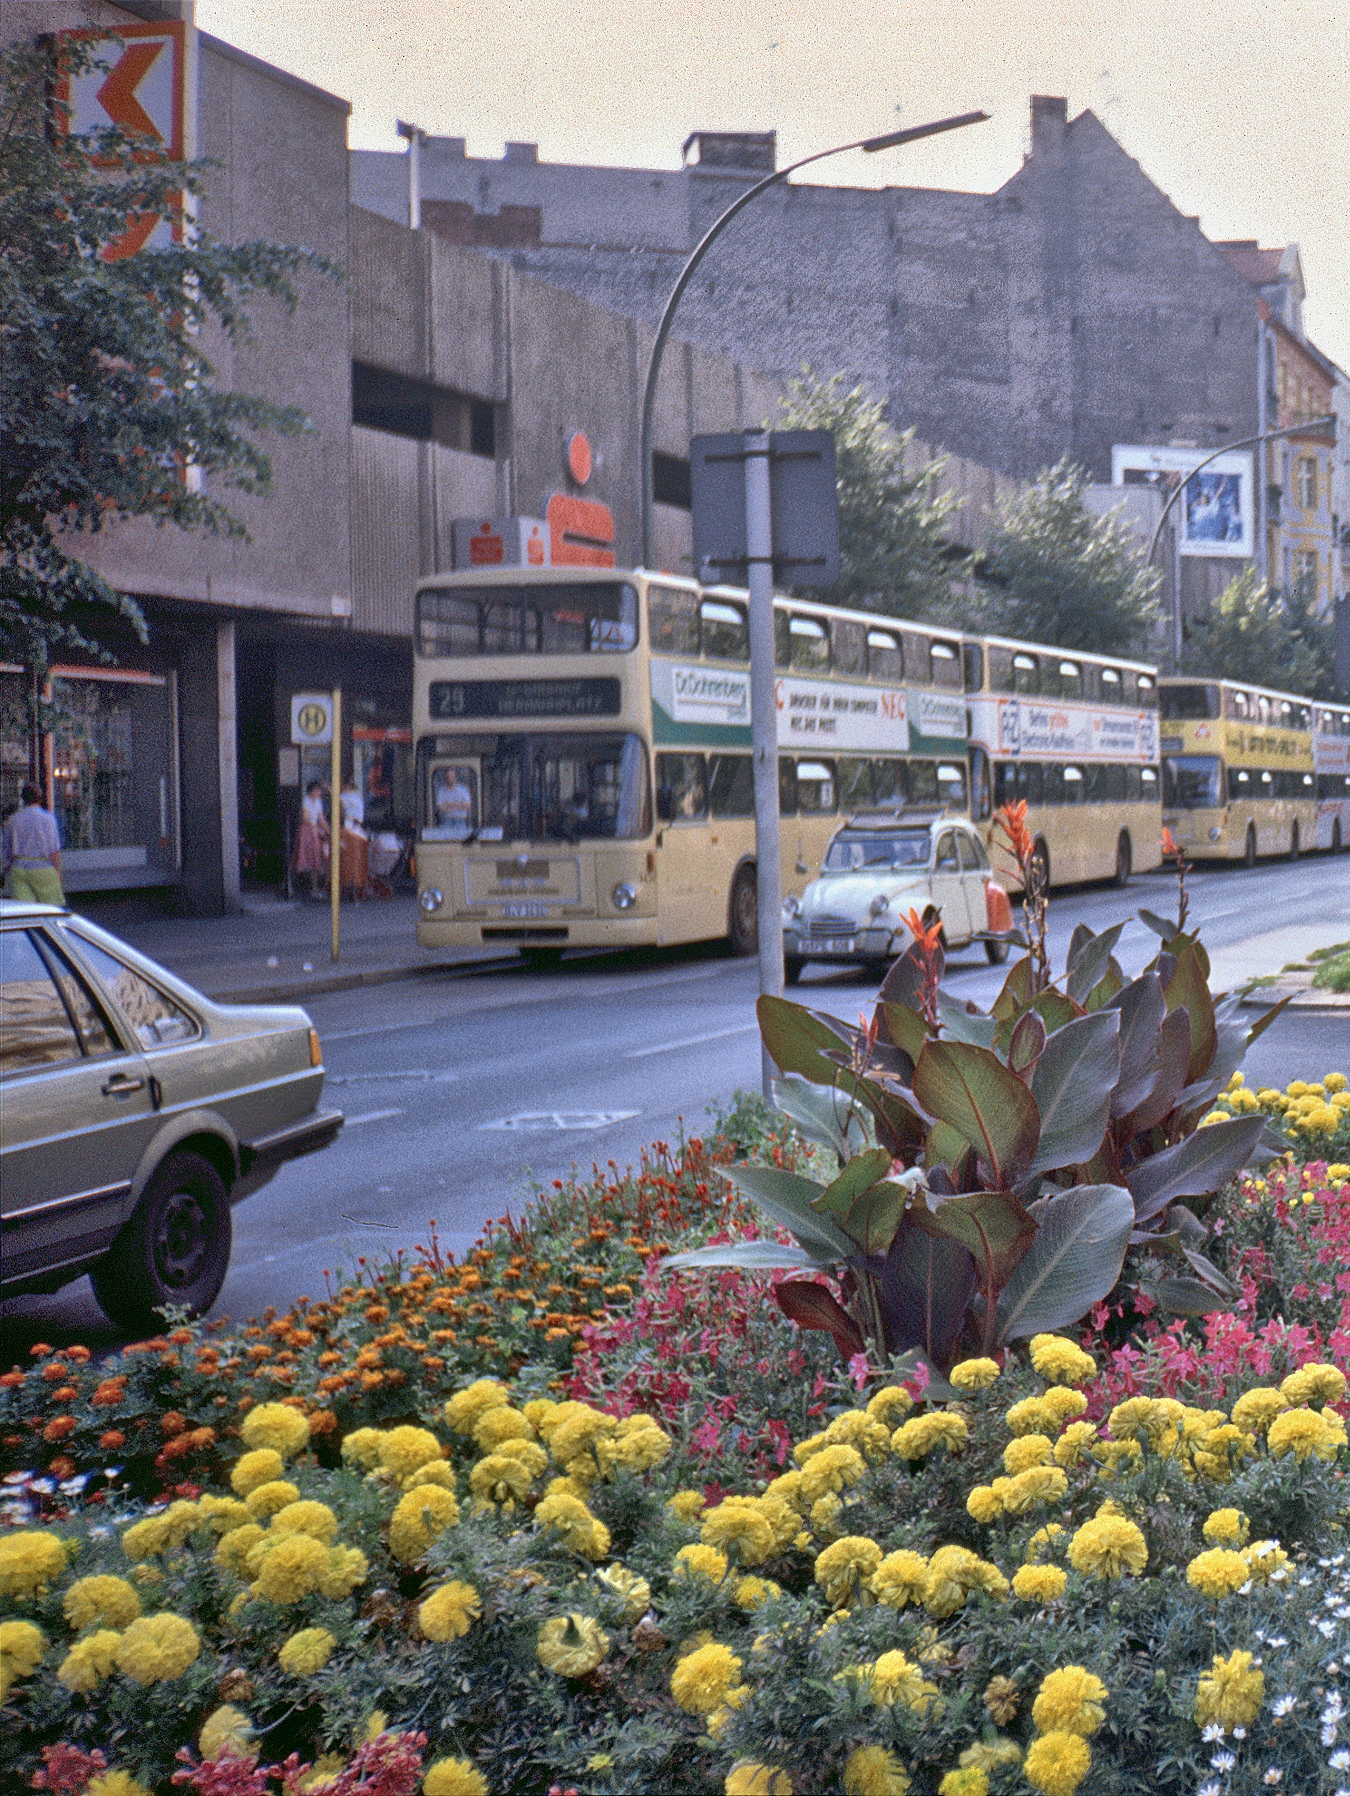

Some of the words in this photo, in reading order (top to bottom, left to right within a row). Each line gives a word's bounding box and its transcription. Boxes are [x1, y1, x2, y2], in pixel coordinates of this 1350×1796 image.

[439, 686, 465, 713] 29
[881, 692, 906, 720] NEC
[305, 711, 319, 730] H
